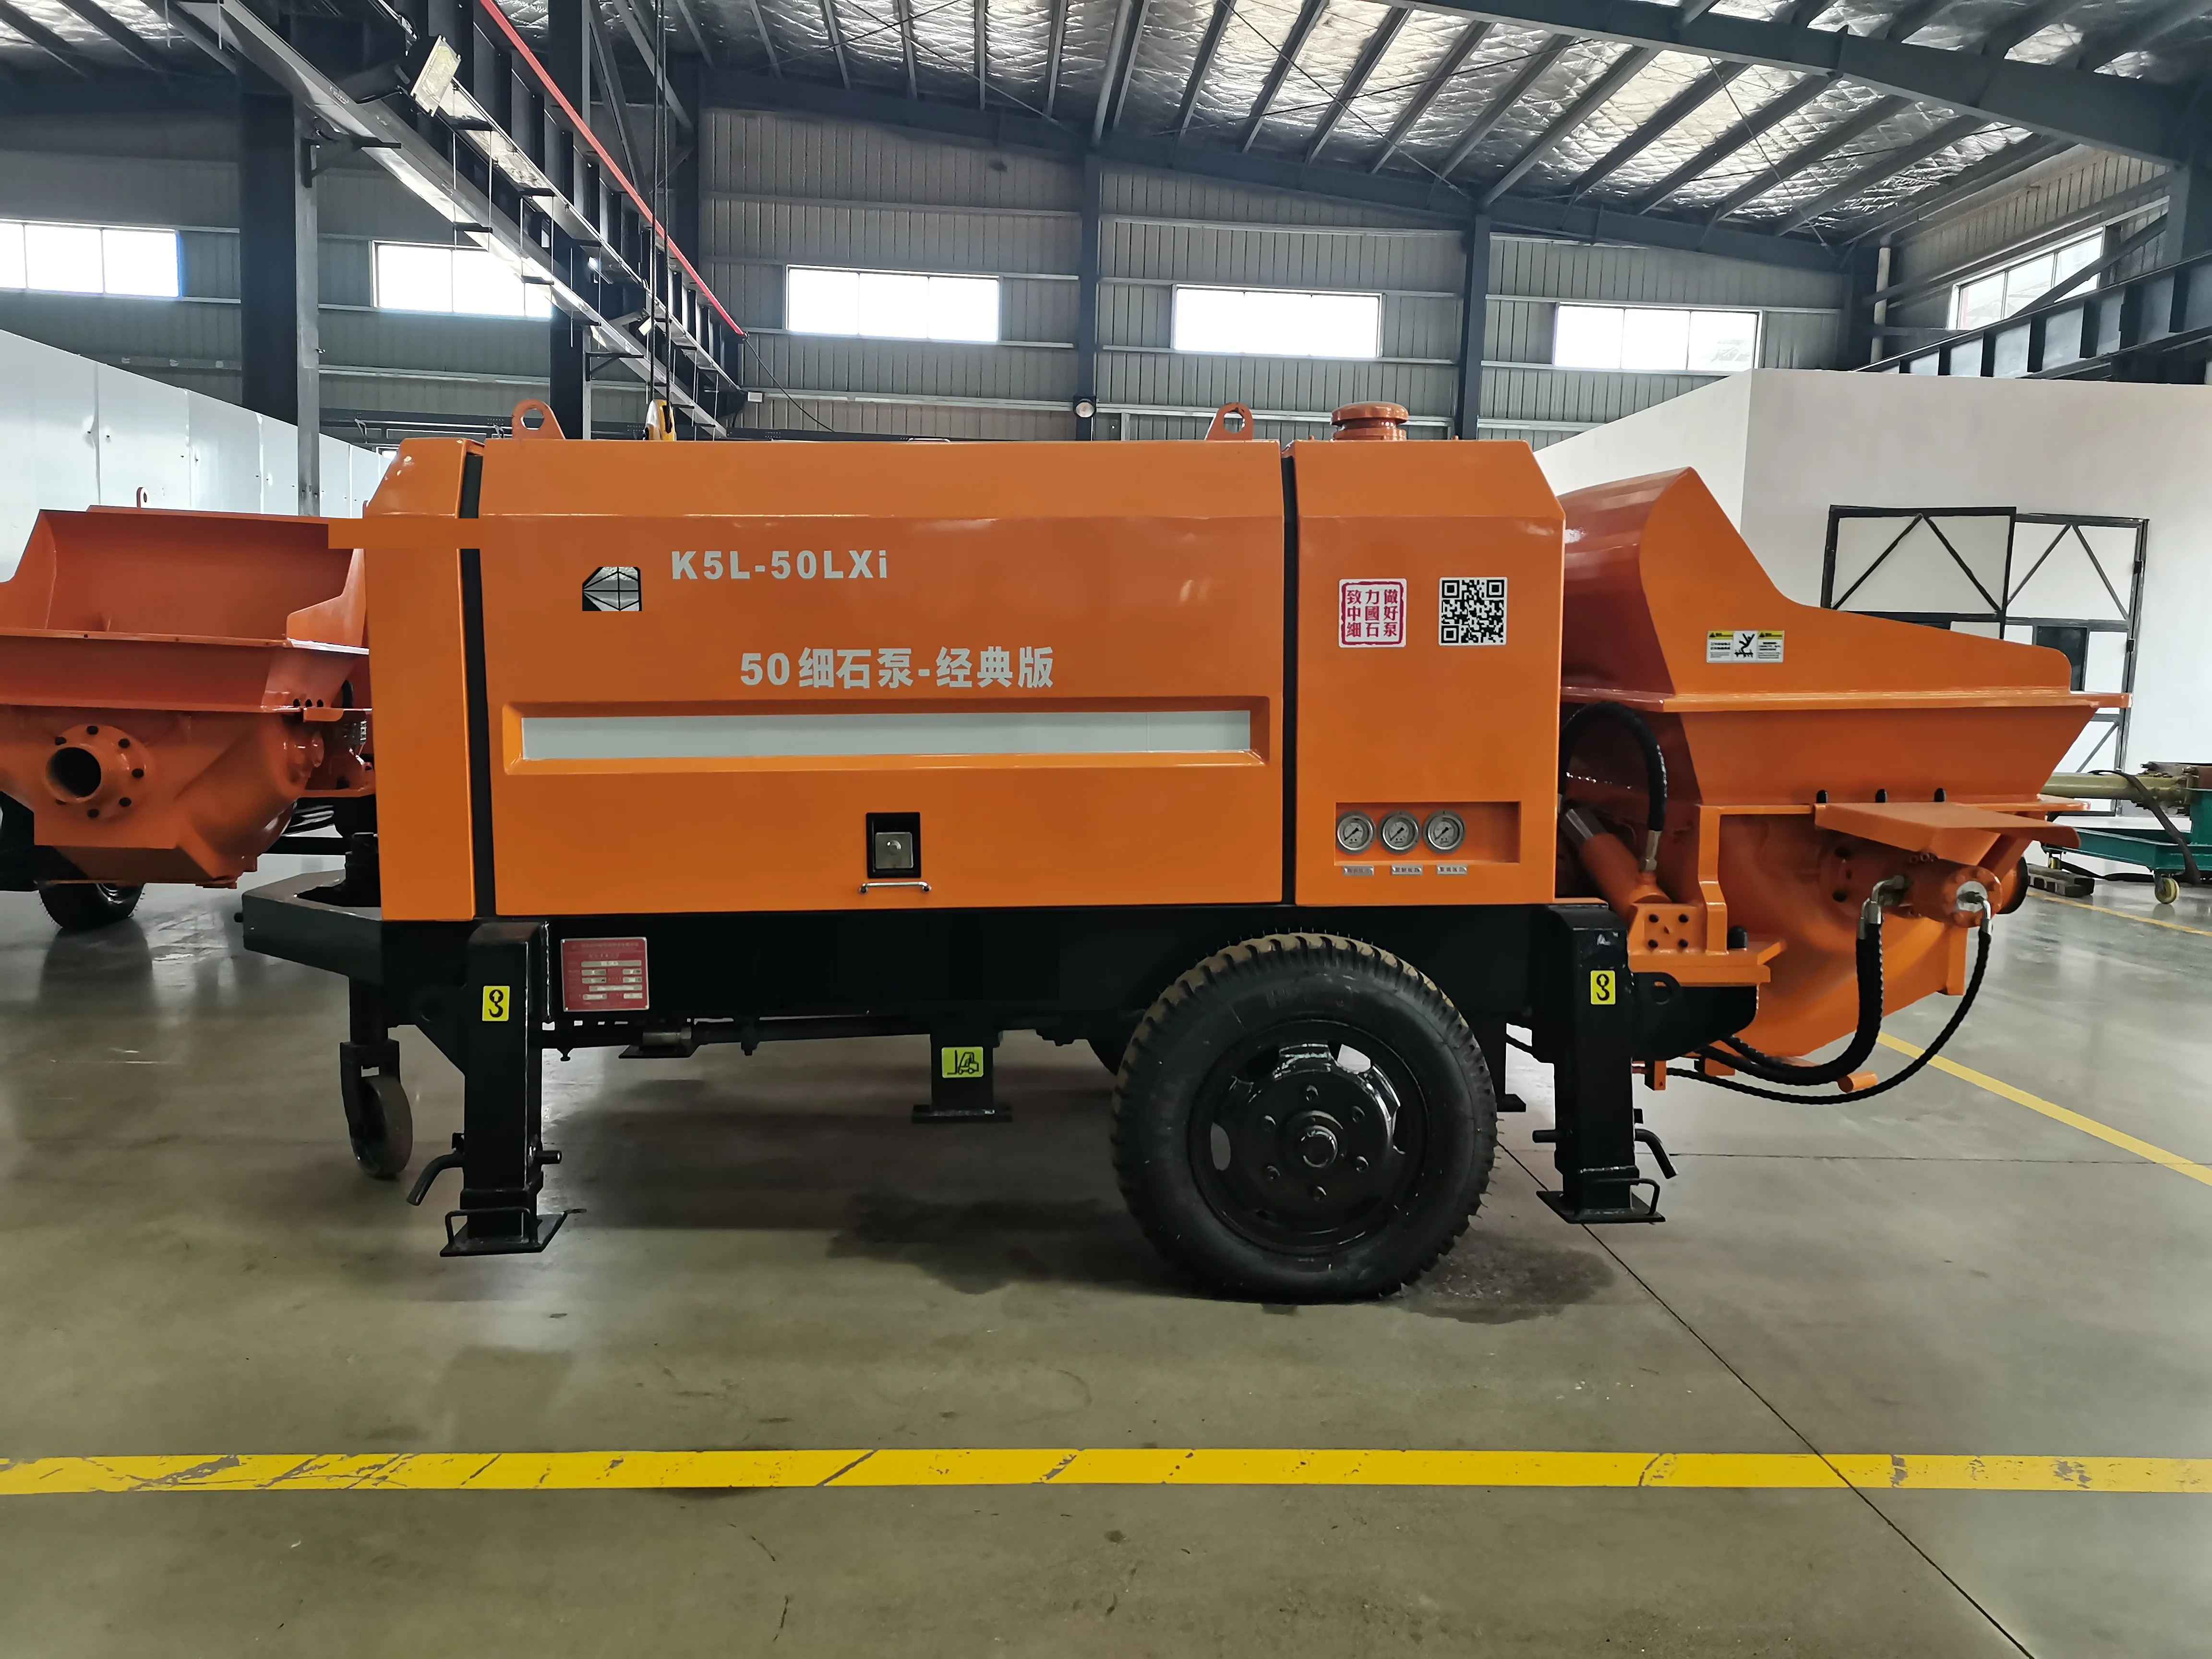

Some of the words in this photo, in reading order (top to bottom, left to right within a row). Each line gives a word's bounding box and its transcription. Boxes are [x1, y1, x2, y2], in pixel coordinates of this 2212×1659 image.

[672, 550, 887, 580] K5L-50LXi
[1347, 589, 1398, 605] 致力做
[1347, 605, 1398, 622] 中國好
